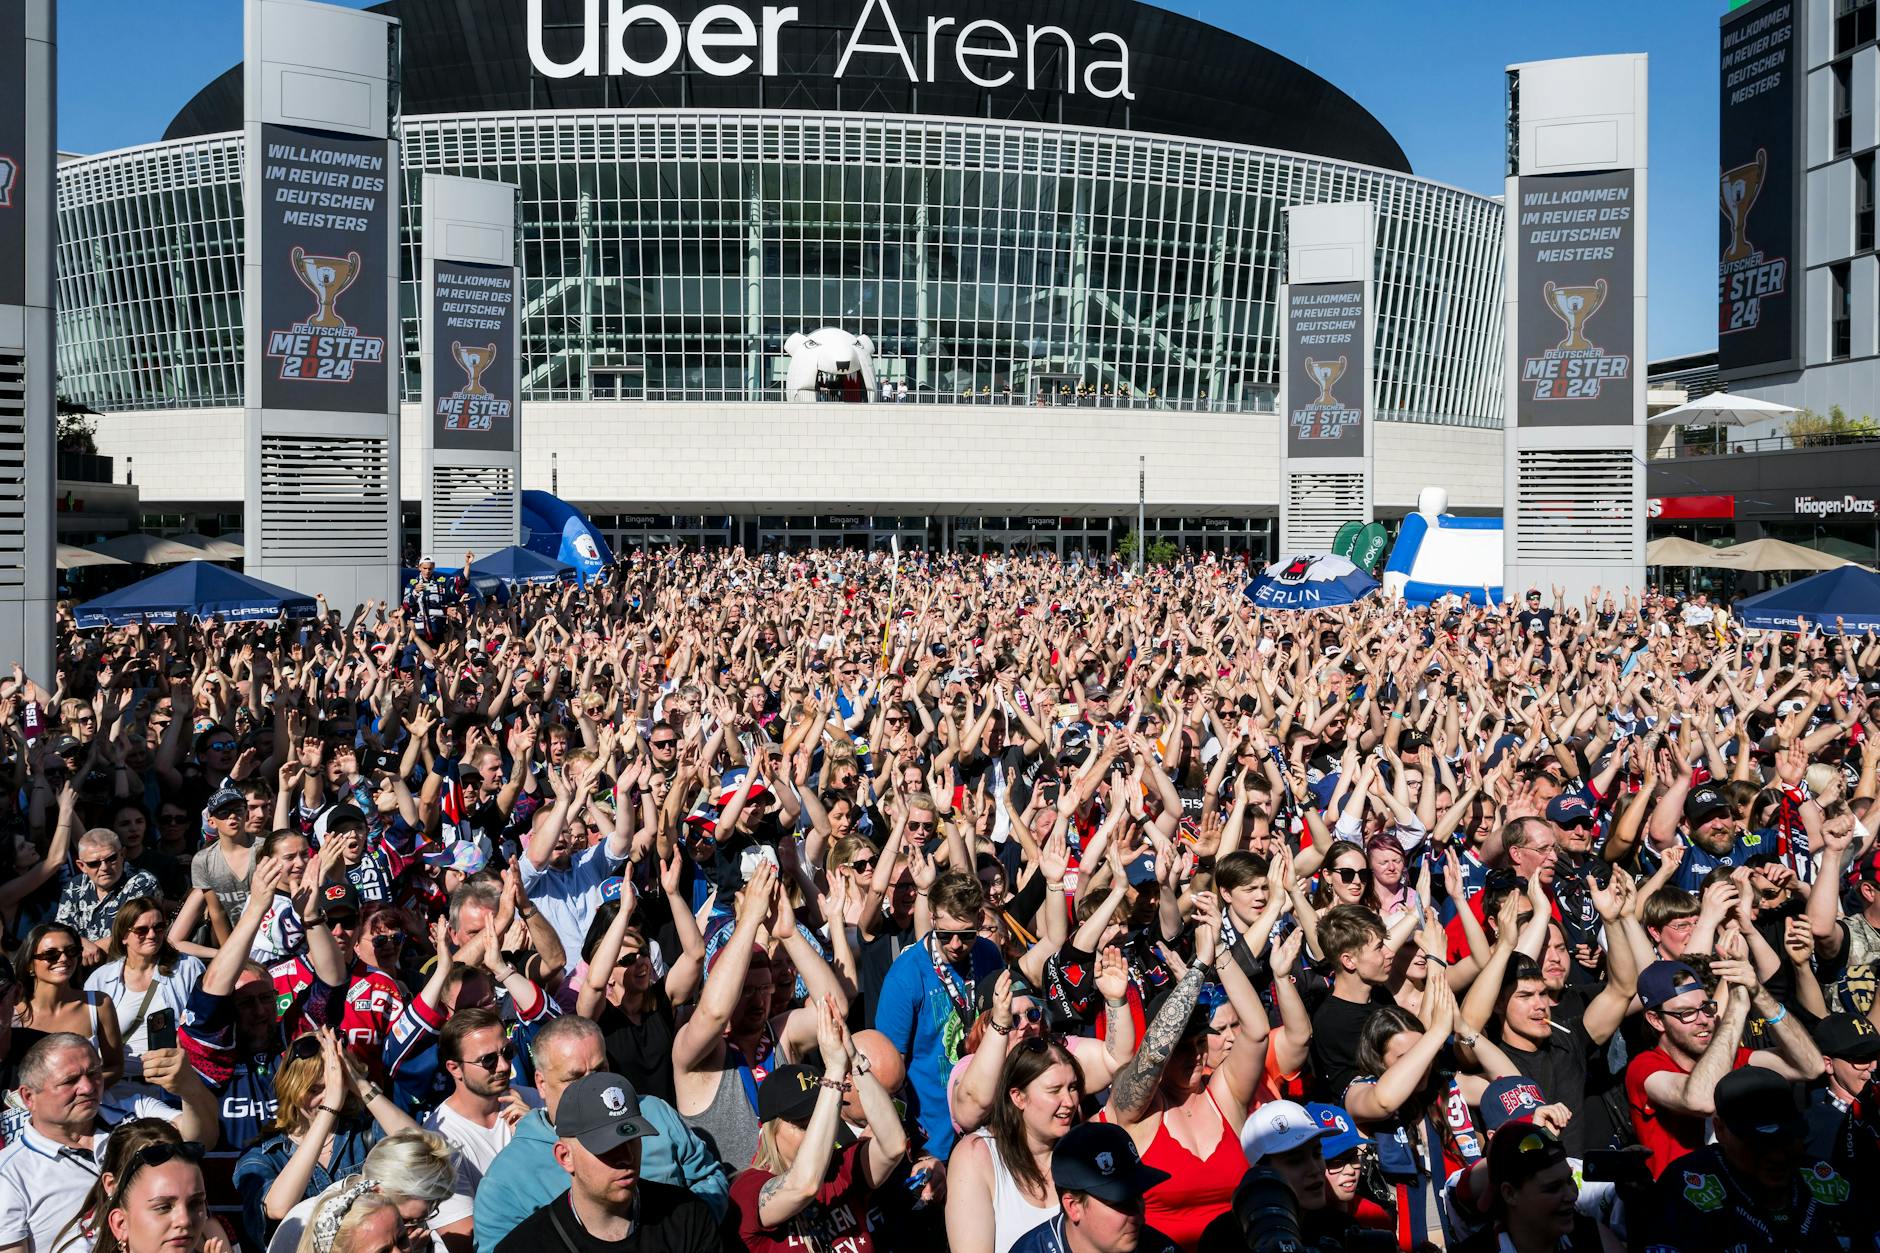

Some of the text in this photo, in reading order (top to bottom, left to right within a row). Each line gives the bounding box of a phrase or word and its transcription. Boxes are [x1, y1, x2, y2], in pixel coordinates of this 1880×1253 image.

[1723, 3, 1791, 50] WILLKOMMEN
[834, 0, 1134, 100] Arena
[1722, 24, 1792, 71] IM REVIER DES
[1727, 47, 1786, 88] DEUTSCHEN
[1730, 72, 1781, 106] MEISTERS
[268, 143, 383, 171] WILLKOMMEN
[265, 165, 385, 192] IM REVIER DES
[275, 187, 375, 212] DEUTSCHEN
[1523, 187, 1629, 206] WILLKOMMEN
[283, 210, 368, 232] MEISTERS
[1521, 206, 1631, 225] IM REVIER DES
[1530, 226, 1622, 244] DEUTSCHEN
[1536, 246, 1615, 263] MEISTERS
[1720, 255, 1761, 275] EUTSCHER
[438, 273, 511, 289] WILLKOMMEN
[436, 288, 512, 302] IM REVIER DES
[1292, 293, 1361, 305] WILLKOMMEN
[442, 302, 506, 316] DEUTSCHEN
[1290, 307, 1362, 318] IM REVIER DES
[1719, 298, 1758, 330] 024
[294, 325, 355, 337] DEUTSCHER
[447, 317, 501, 330] MEISTERS
[1296, 320, 1356, 331] DEUTSCHEN
[270, 333, 381, 360] MEISTER
[1300, 334, 1352, 344] MEISTERS
[1546, 350, 1601, 359] DEUTSCHER
[283, 356, 351, 380] 2024
[1525, 358, 1627, 379] MEISTER
[1536, 378, 1598, 398] 2024
[439, 400, 510, 415] MEISTER
[447, 414, 490, 429] 2024
[1293, 411, 1360, 424] MEISTER
[1300, 424, 1341, 438] 2024
[1794, 495, 1876, 518] Häagen-Dazs
[625, 515, 655, 524] Eingang
[829, 515, 859, 524] Eingang
[1027, 516, 1055, 525] Eingang
[1205, 517, 1230, 526] Eingang
[1362, 546, 1379, 567] AOK
[1255, 584, 1320, 604] BERLIN
[231, 606, 279, 616] GASAG
[361, 856, 382, 900] EISB
[223, 1097, 279, 1121] GAS
